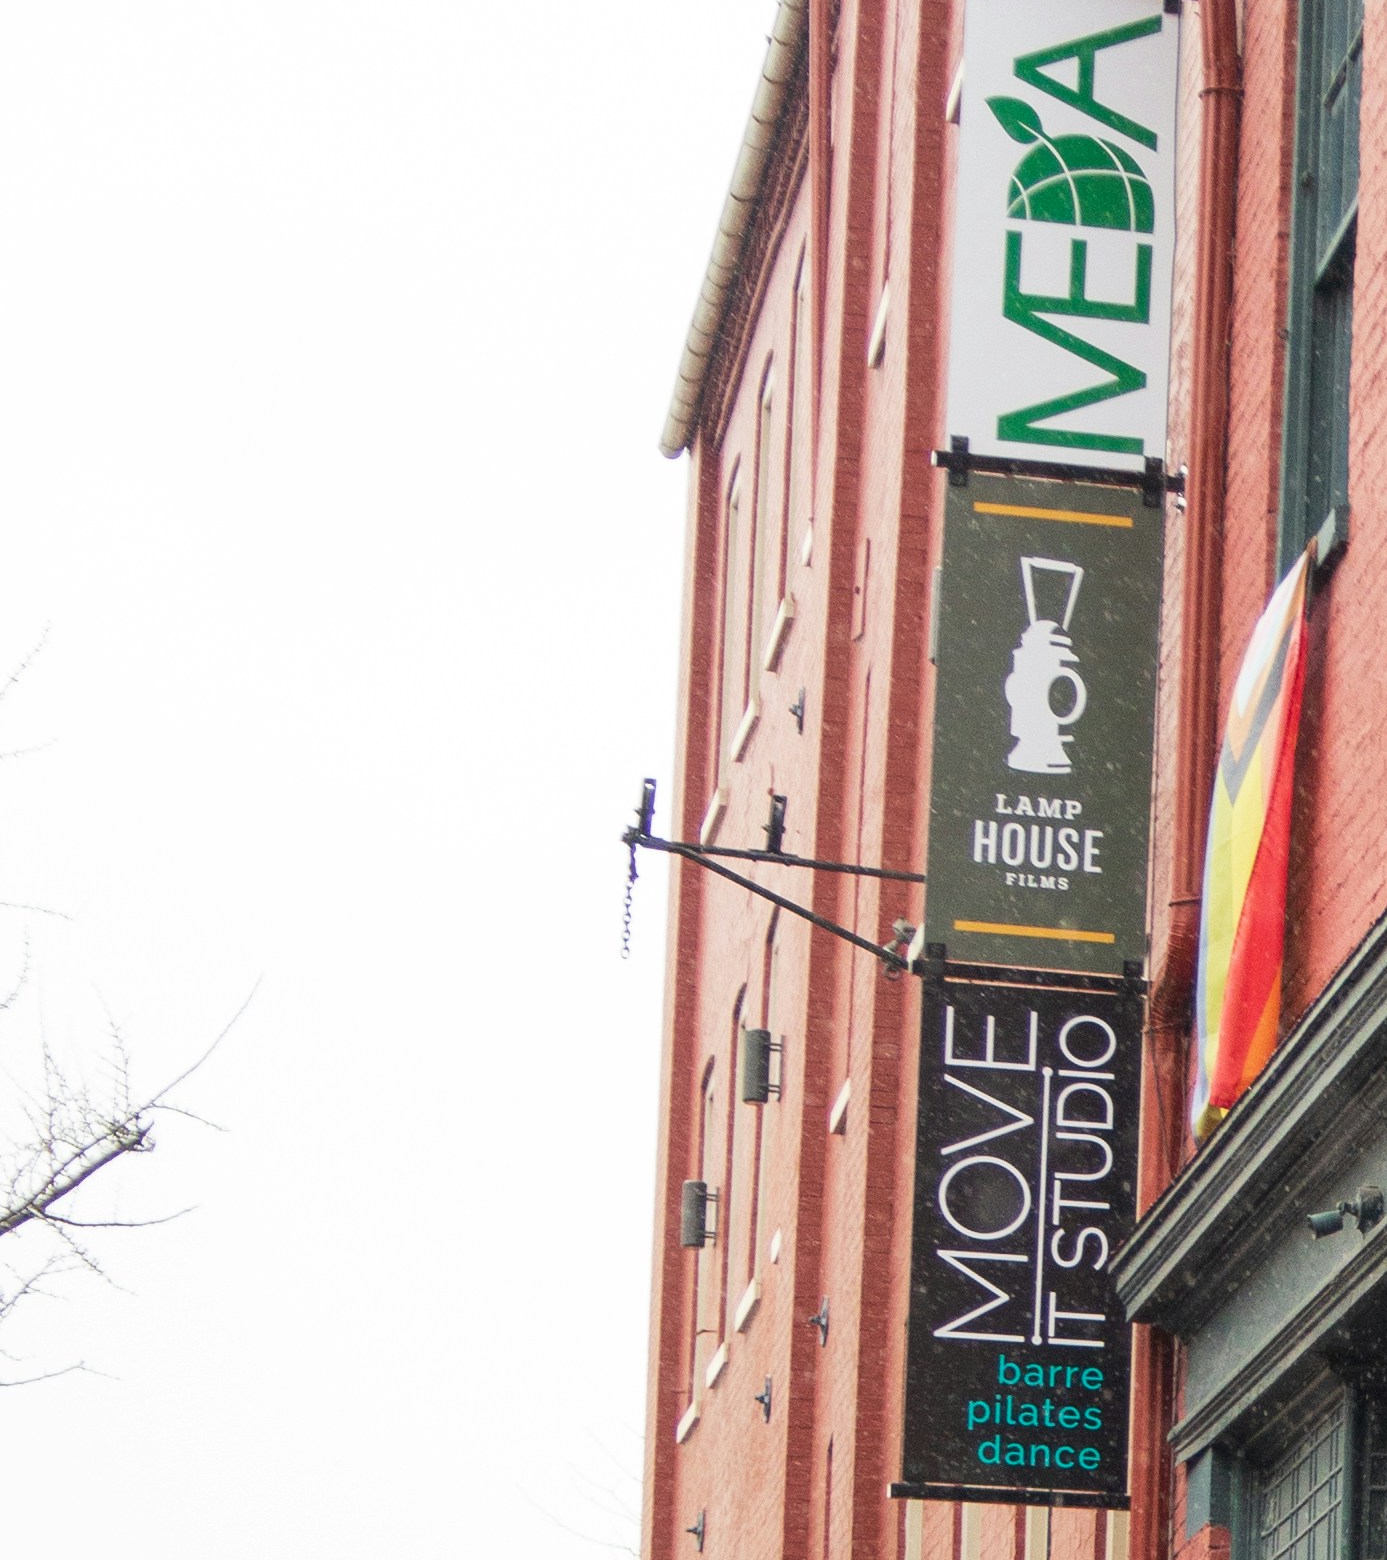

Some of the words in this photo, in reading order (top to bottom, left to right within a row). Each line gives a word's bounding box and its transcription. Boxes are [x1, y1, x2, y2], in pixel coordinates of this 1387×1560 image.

[992, 13, 1162, 455] MEDA
[995, 792, 1083, 820] LAMP
[972, 818, 1105, 874] HOUSE
[1005, 871, 1070, 892] FILMS
[1050, 1015, 1117, 1271] STUDIO
[933, 1005, 1038, 1343] MOVE
[1048, 1291, 1106, 1348] IT
[998, 1353, 1105, 1391] barre
[967, 1393, 1103, 1431] pilates
[977, 1437, 1101, 1470] dance
